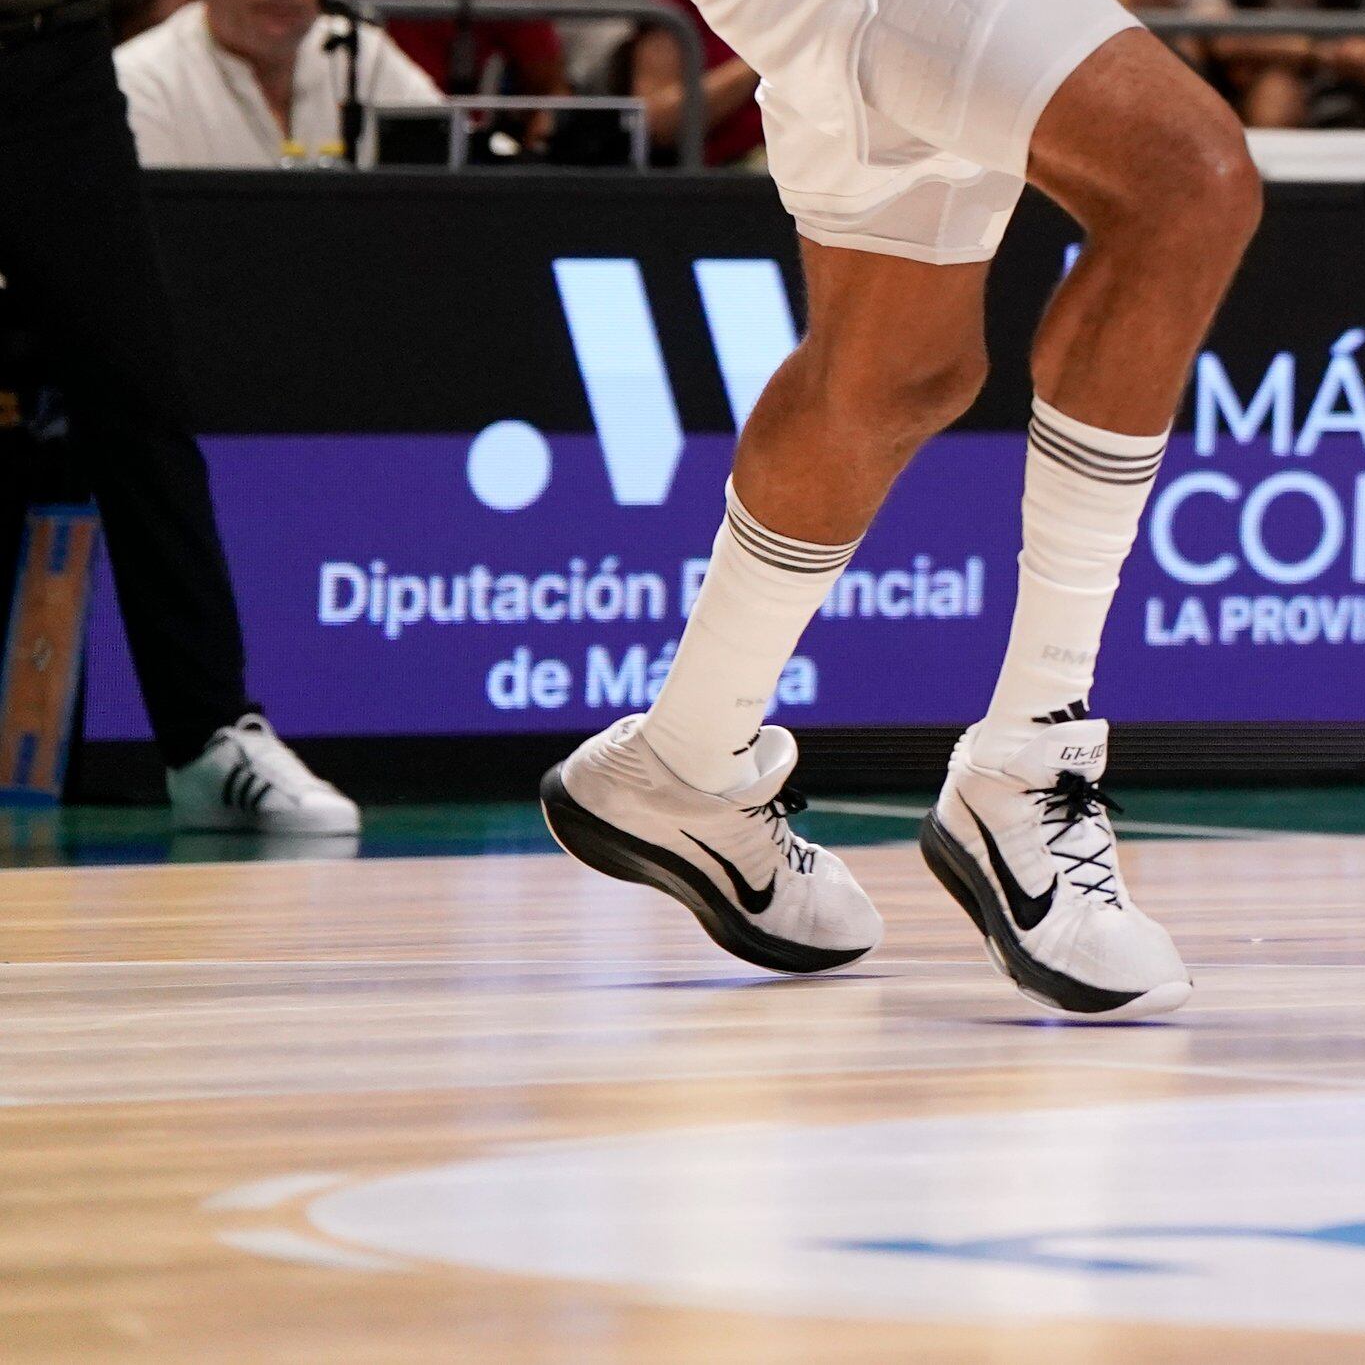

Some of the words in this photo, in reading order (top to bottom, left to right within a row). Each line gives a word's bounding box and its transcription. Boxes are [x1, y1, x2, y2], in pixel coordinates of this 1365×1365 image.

[318, 557, 667, 638] Diputación
[1145, 600, 1211, 646] LA
[486, 646, 569, 709] de
